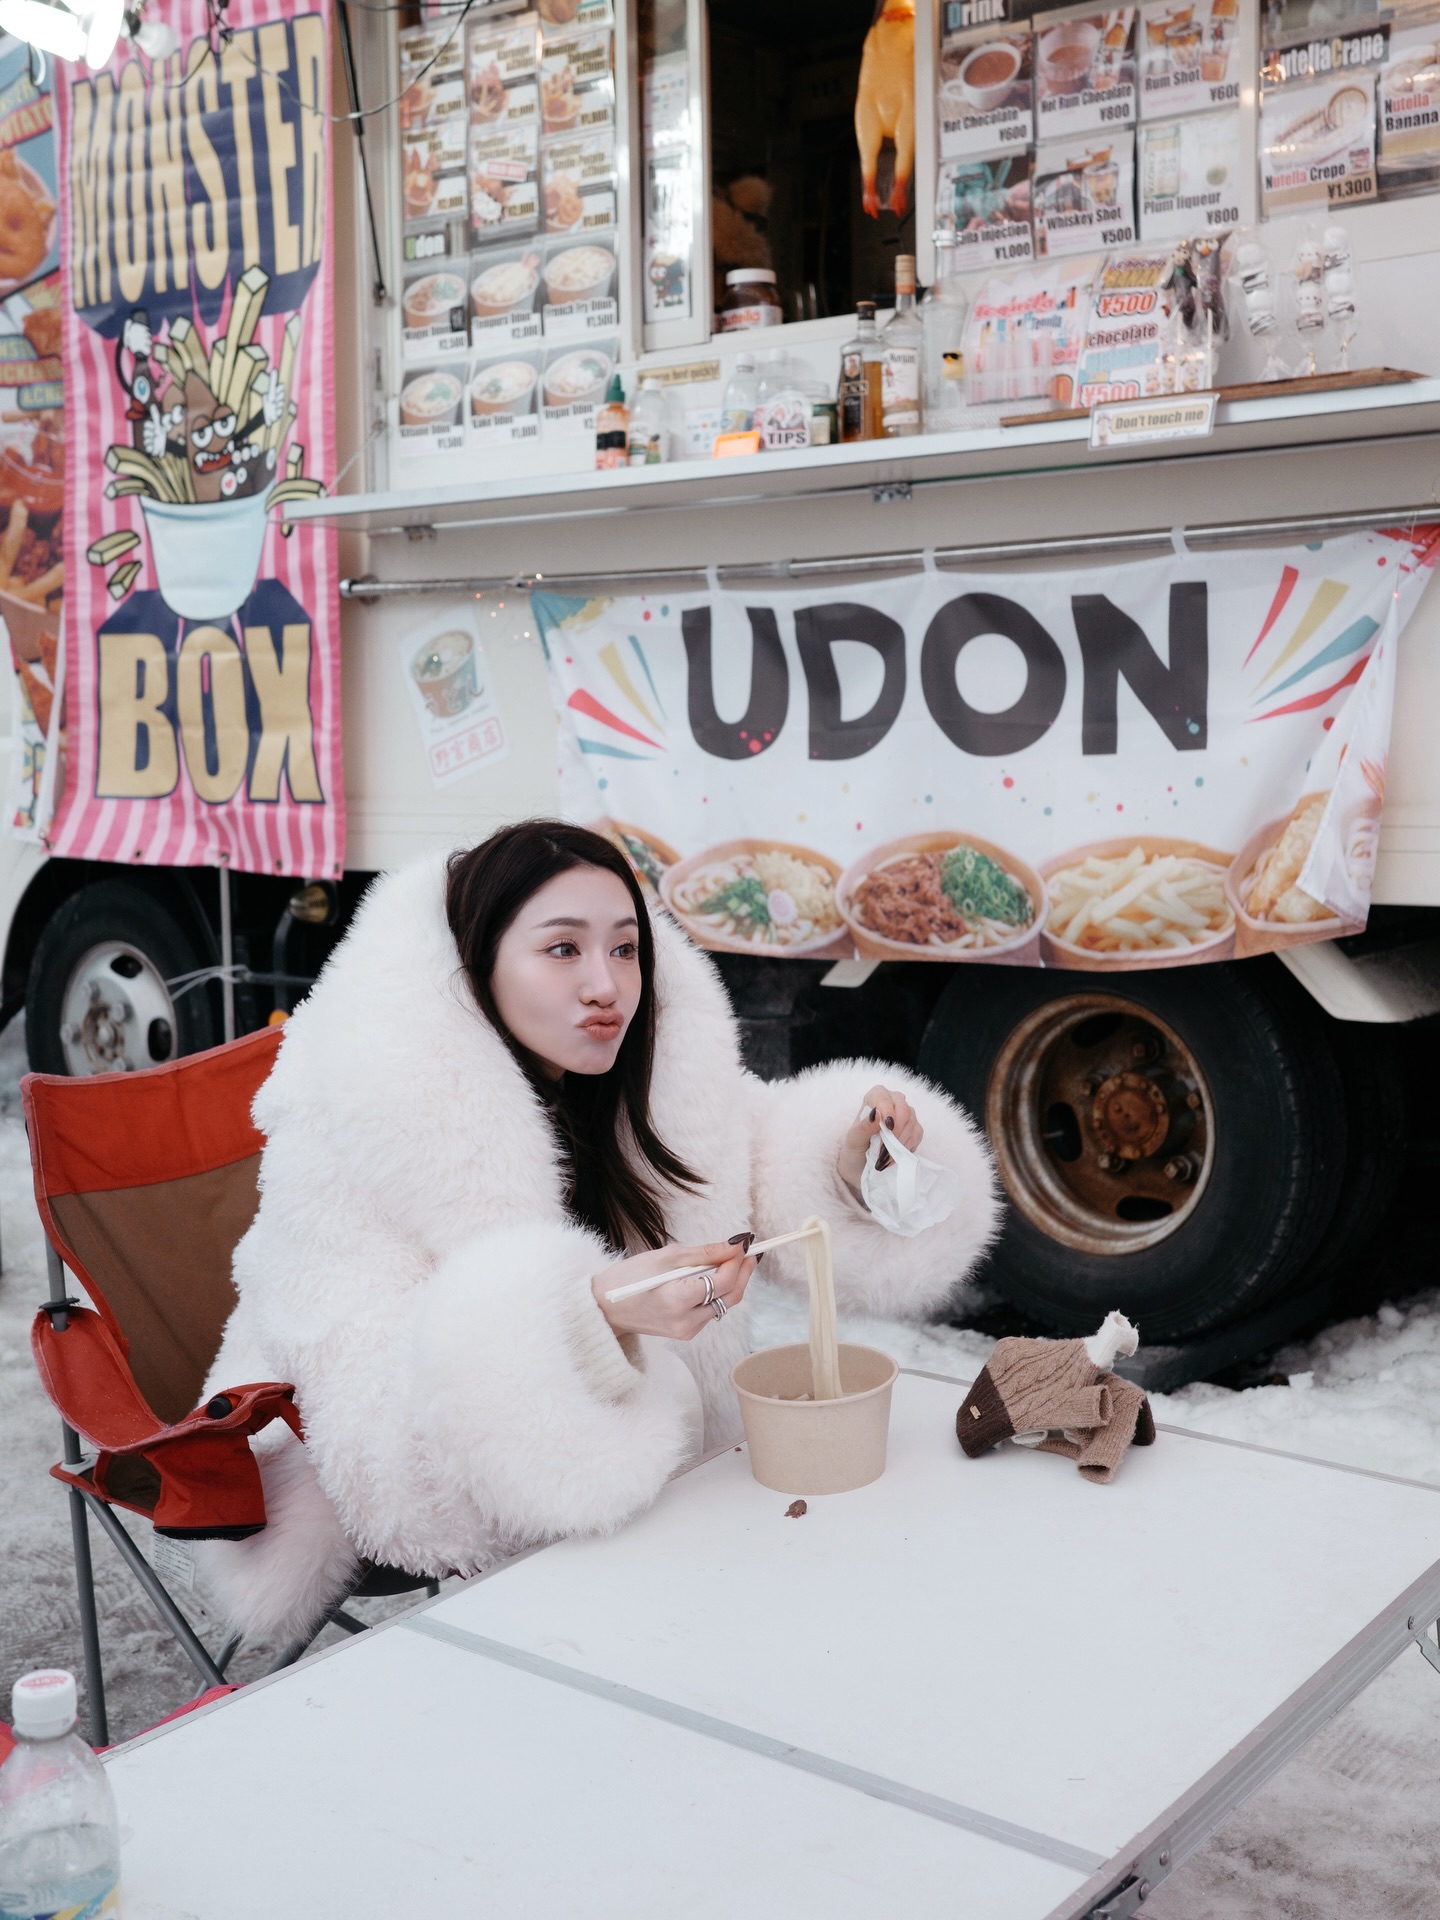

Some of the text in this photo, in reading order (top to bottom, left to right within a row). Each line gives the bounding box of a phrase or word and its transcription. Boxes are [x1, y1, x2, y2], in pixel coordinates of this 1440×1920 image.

[947, 0, 1006, 29] Drink
[1145, 69, 1200, 91] Rum Shot
[1059, 95, 1080, 109] Rum
[1082, 84, 1133, 105] Chocolate
[1384, 93, 1429, 114] Nutella
[944, 109, 1019, 133] Hot Chocolate
[1100, 103, 1130, 121] ¥800
[1385, 111, 1438, 131] Banana
[999, 124, 1027, 142] ¥600
[71, 14, 325, 309] MONSTER
[1266, 163, 1346, 189] Nutella Crepe
[1327, 178, 1372, 199] ¥1,300
[1143, 192, 1222, 215] Plum liqueur
[1046, 207, 1122, 230] Whiskey Shot
[1206, 207, 1239, 225] ¥800
[1101, 227, 1132, 245] ¥500
[1100, 292, 1157, 316] ¥500
[1088, 323, 1157, 347] chocolate
[1083, 382, 1138, 407] ¥500
[1115, 409, 1204, 430] Don't touch me
[768, 431, 807, 444] TIPS
[680, 581, 1209, 760] UDON
[95, 622, 325, 805] BOX
